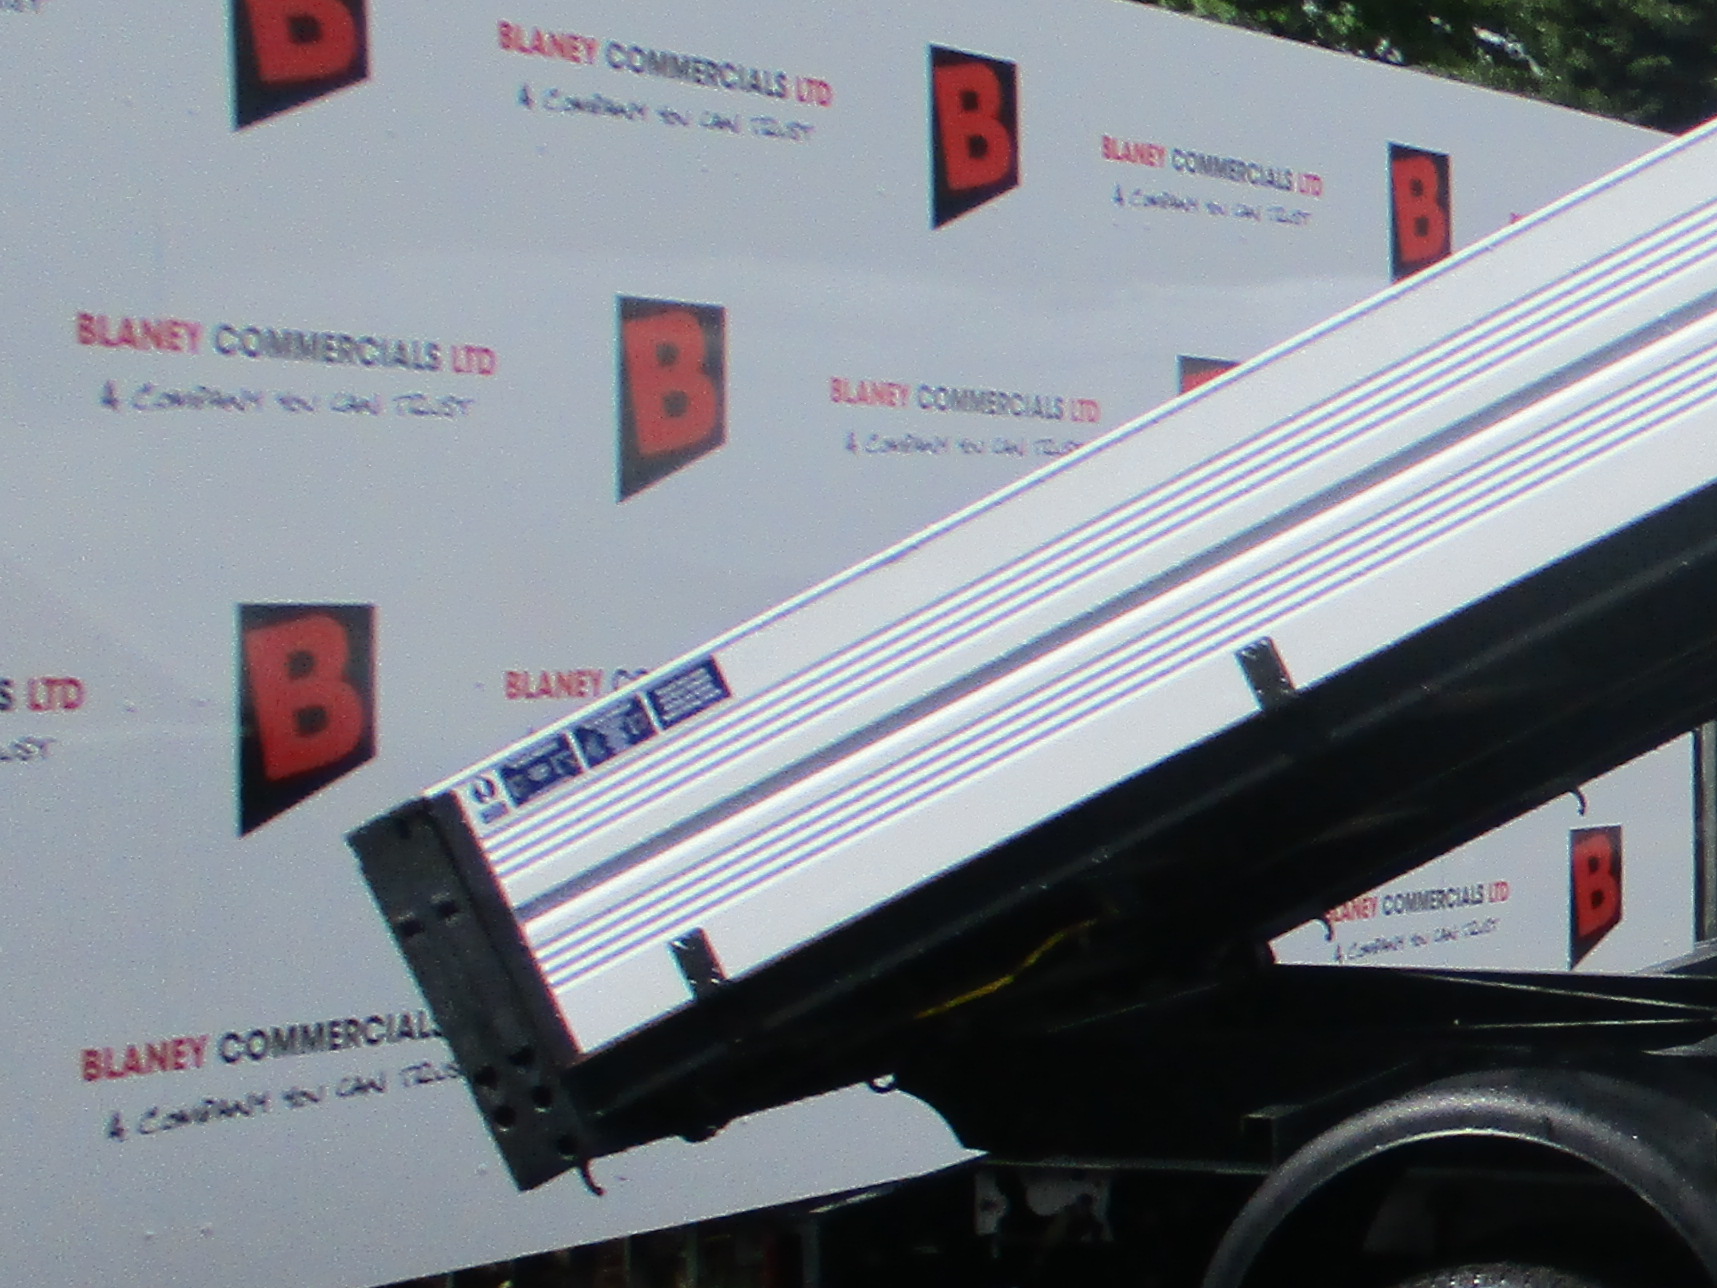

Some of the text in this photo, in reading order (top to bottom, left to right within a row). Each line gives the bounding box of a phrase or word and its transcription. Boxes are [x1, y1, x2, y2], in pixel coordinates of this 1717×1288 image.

[497, 20, 834, 107] BLANEY COMMERCIALS LTD
[934, 61, 1014, 191] B
[1101, 134, 1324, 197] BLANEY COMMERCIALS LTD
[1393, 155, 1447, 263] B
[77, 312, 498, 376] BLANEY COMMERCIALS LTD
[622, 310, 718, 456] B
[830, 376, 1101, 423] BLANEY COMMERCIALS LTD
[26, 678, 84, 712] LTD
[246, 614, 363, 782] B
[505, 669, 604, 700] BLANEY
[1381, 884, 1485, 916] COMMERCIALS
[1489, 881, 1511, 904] LTD
[1574, 834, 1619, 938] B
[80, 1011, 443, 1082] BLANEY COMMERCIAL
